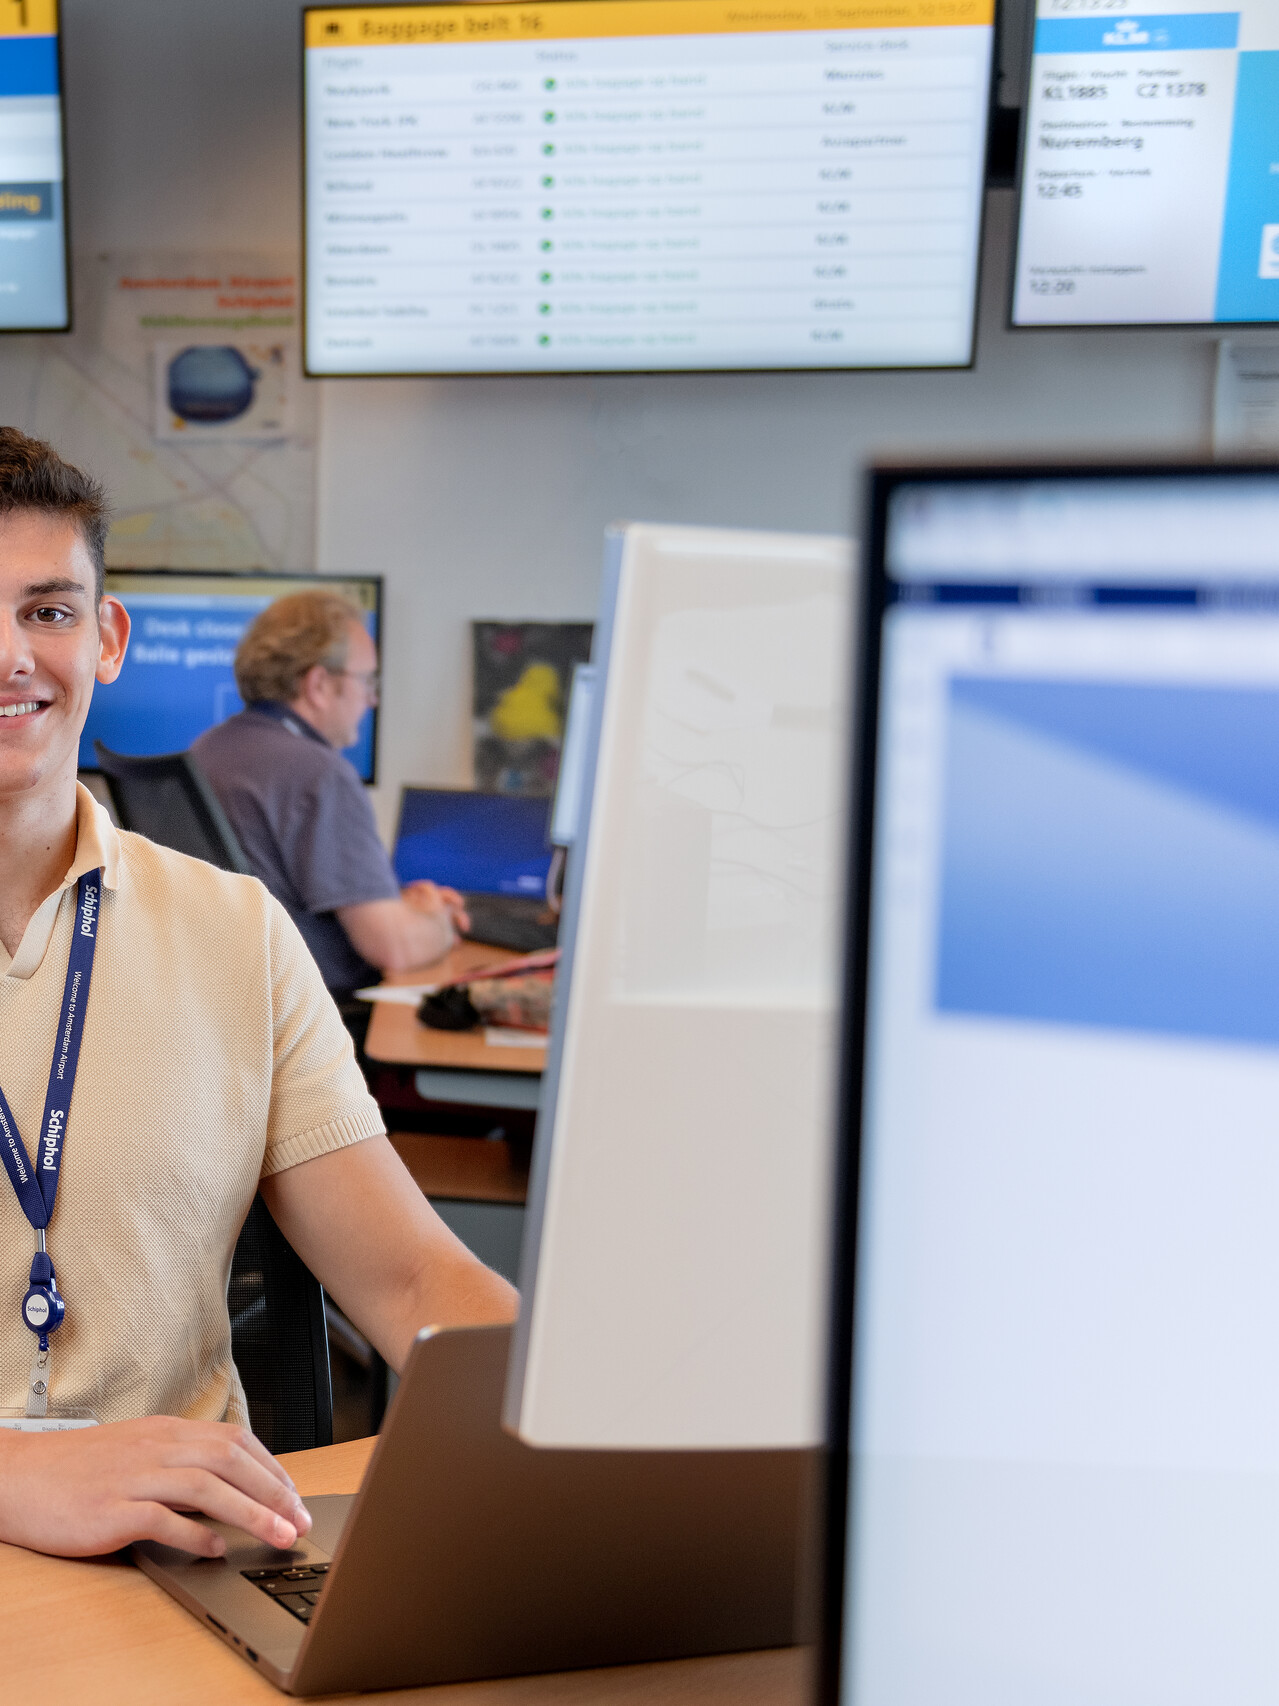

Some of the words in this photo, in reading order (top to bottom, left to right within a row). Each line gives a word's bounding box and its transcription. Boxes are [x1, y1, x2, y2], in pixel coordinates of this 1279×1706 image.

[361, 19, 457, 38] Baggage
[464, 15, 510, 33] belt
[1039, 135, 1145, 151] Nuremberg
[144, 615, 190, 638] Desk
[80, 884, 98, 938] Schiphol
[69, 971, 82, 1003] Welcome
[68, 1003, 76, 1012] to
[61, 1011, 76, 1054] Amsterdam
[56, 1053, 68, 1080] Airport
[8, 1137, 16, 1148] to
[42, 1109, 65, 1171] Schiphol
[11, 1147, 29, 1184] Welcome
[27, 1305, 48, 1313] Schiphol
